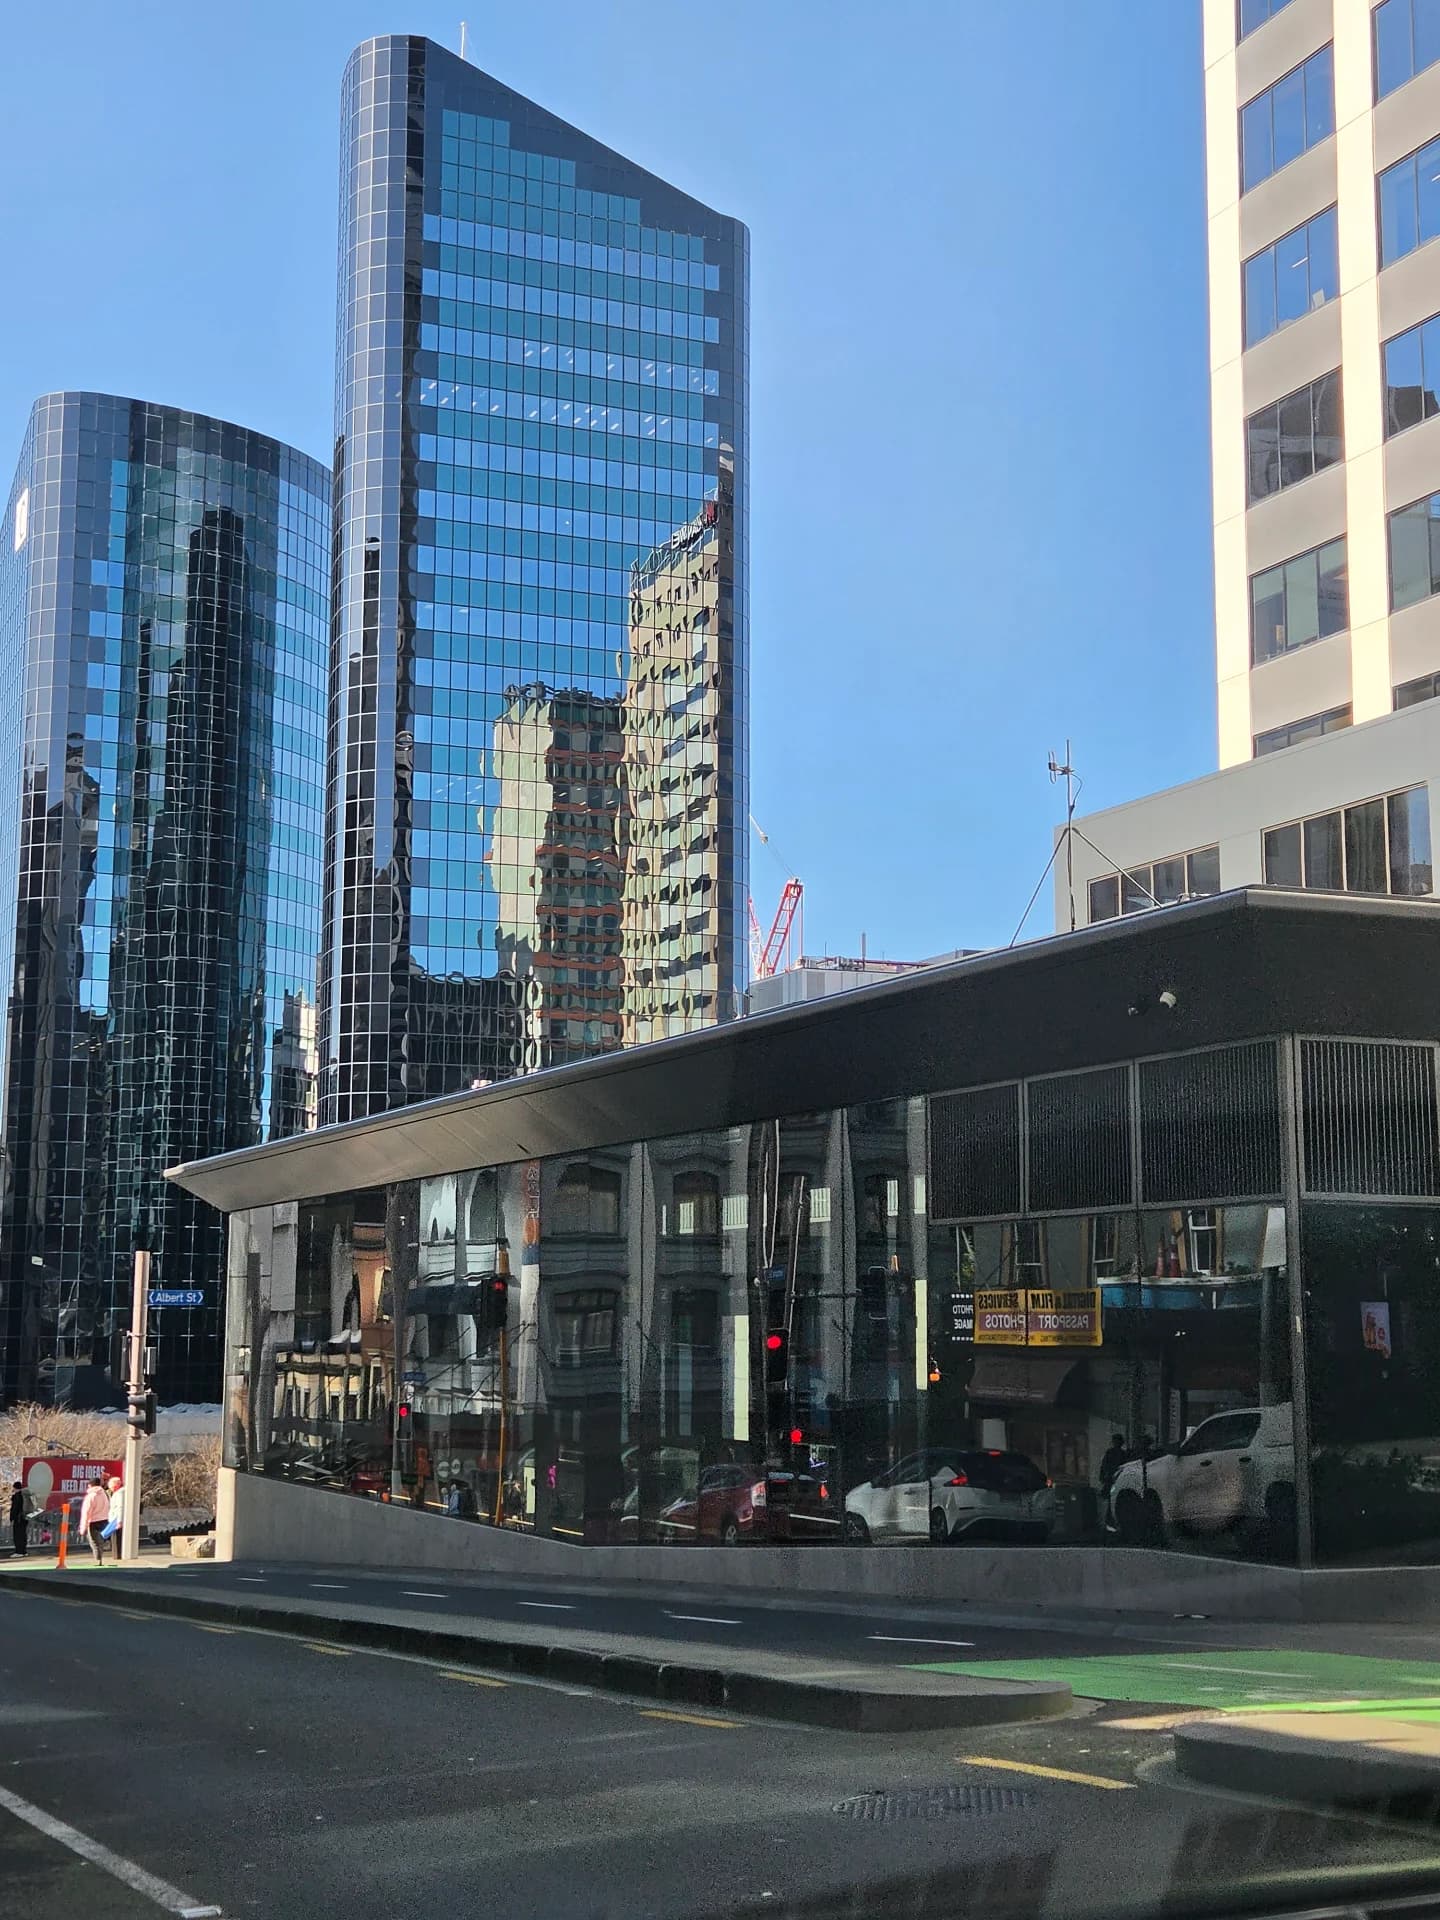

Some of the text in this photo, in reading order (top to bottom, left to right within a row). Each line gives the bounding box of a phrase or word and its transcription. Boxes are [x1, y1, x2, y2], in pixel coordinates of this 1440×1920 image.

[155, 1292, 197, 1303] Albert St
[72, 1465, 84, 1478] BIG
[62, 1480, 78, 1493] NEED
